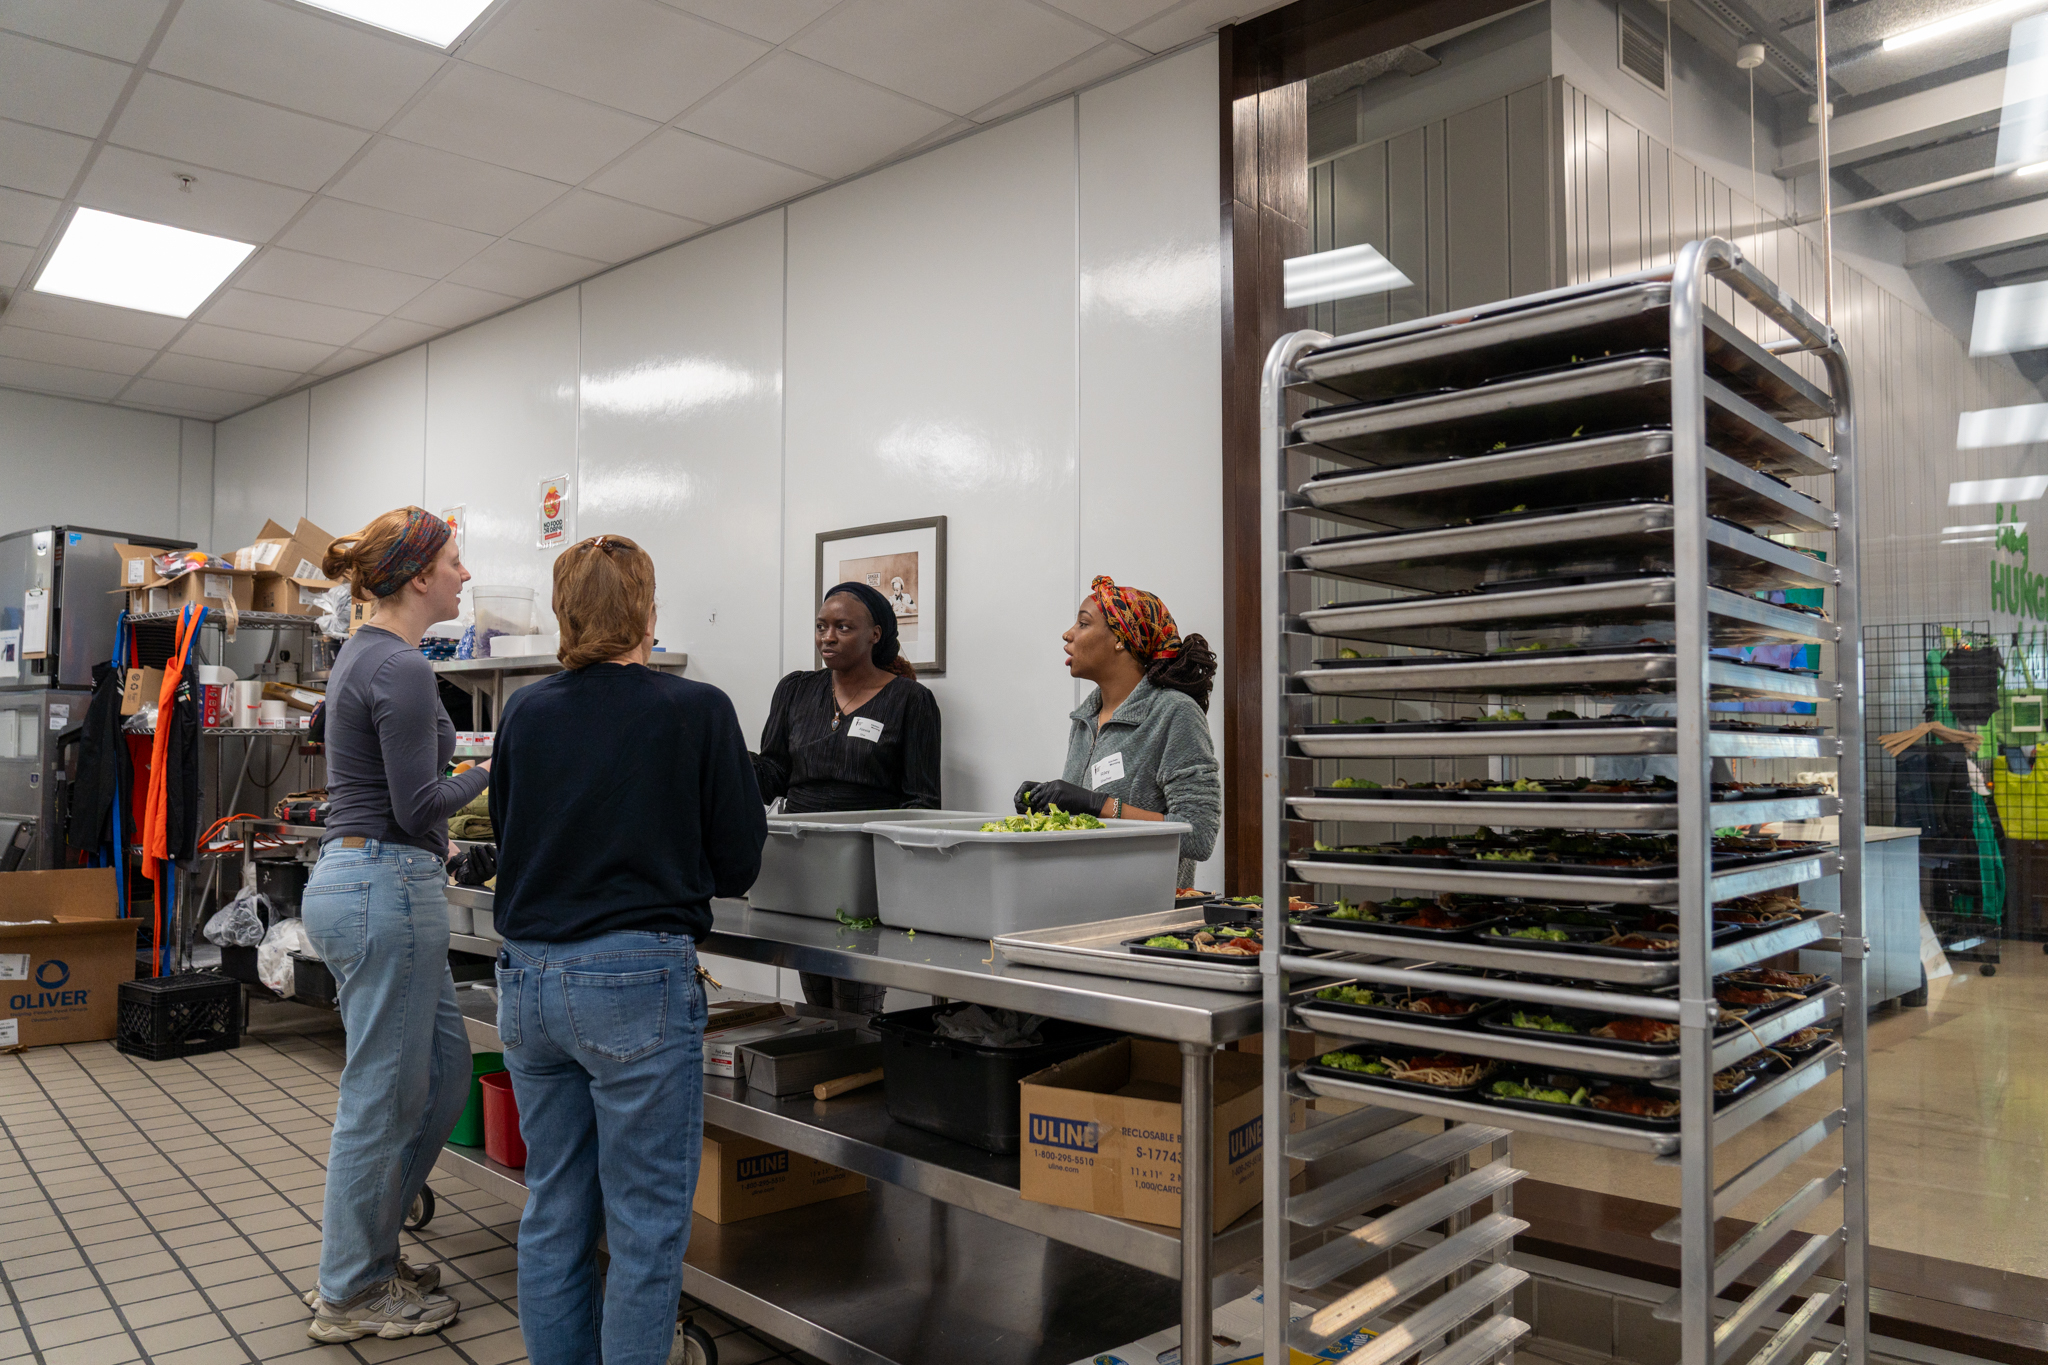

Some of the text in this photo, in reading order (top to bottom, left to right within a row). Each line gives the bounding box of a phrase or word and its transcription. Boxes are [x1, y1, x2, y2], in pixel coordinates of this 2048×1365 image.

[550, 524, 563, 532] DRINK
[10, 990, 88, 1010] OLIVER
[1033, 1118, 1095, 1148] ULINE
[1122, 1127, 1174, 1143] RECLOSABLE
[1231, 1120, 1262, 1158] ULINE
[740, 1154, 786, 1178] ULINE
[1034, 1149, 1094, 1166] 1-800-295-5510
[1048, 1163, 1079, 1174] uline.com
[1135, 1180, 1182, 1195] 1,000/CARTO
